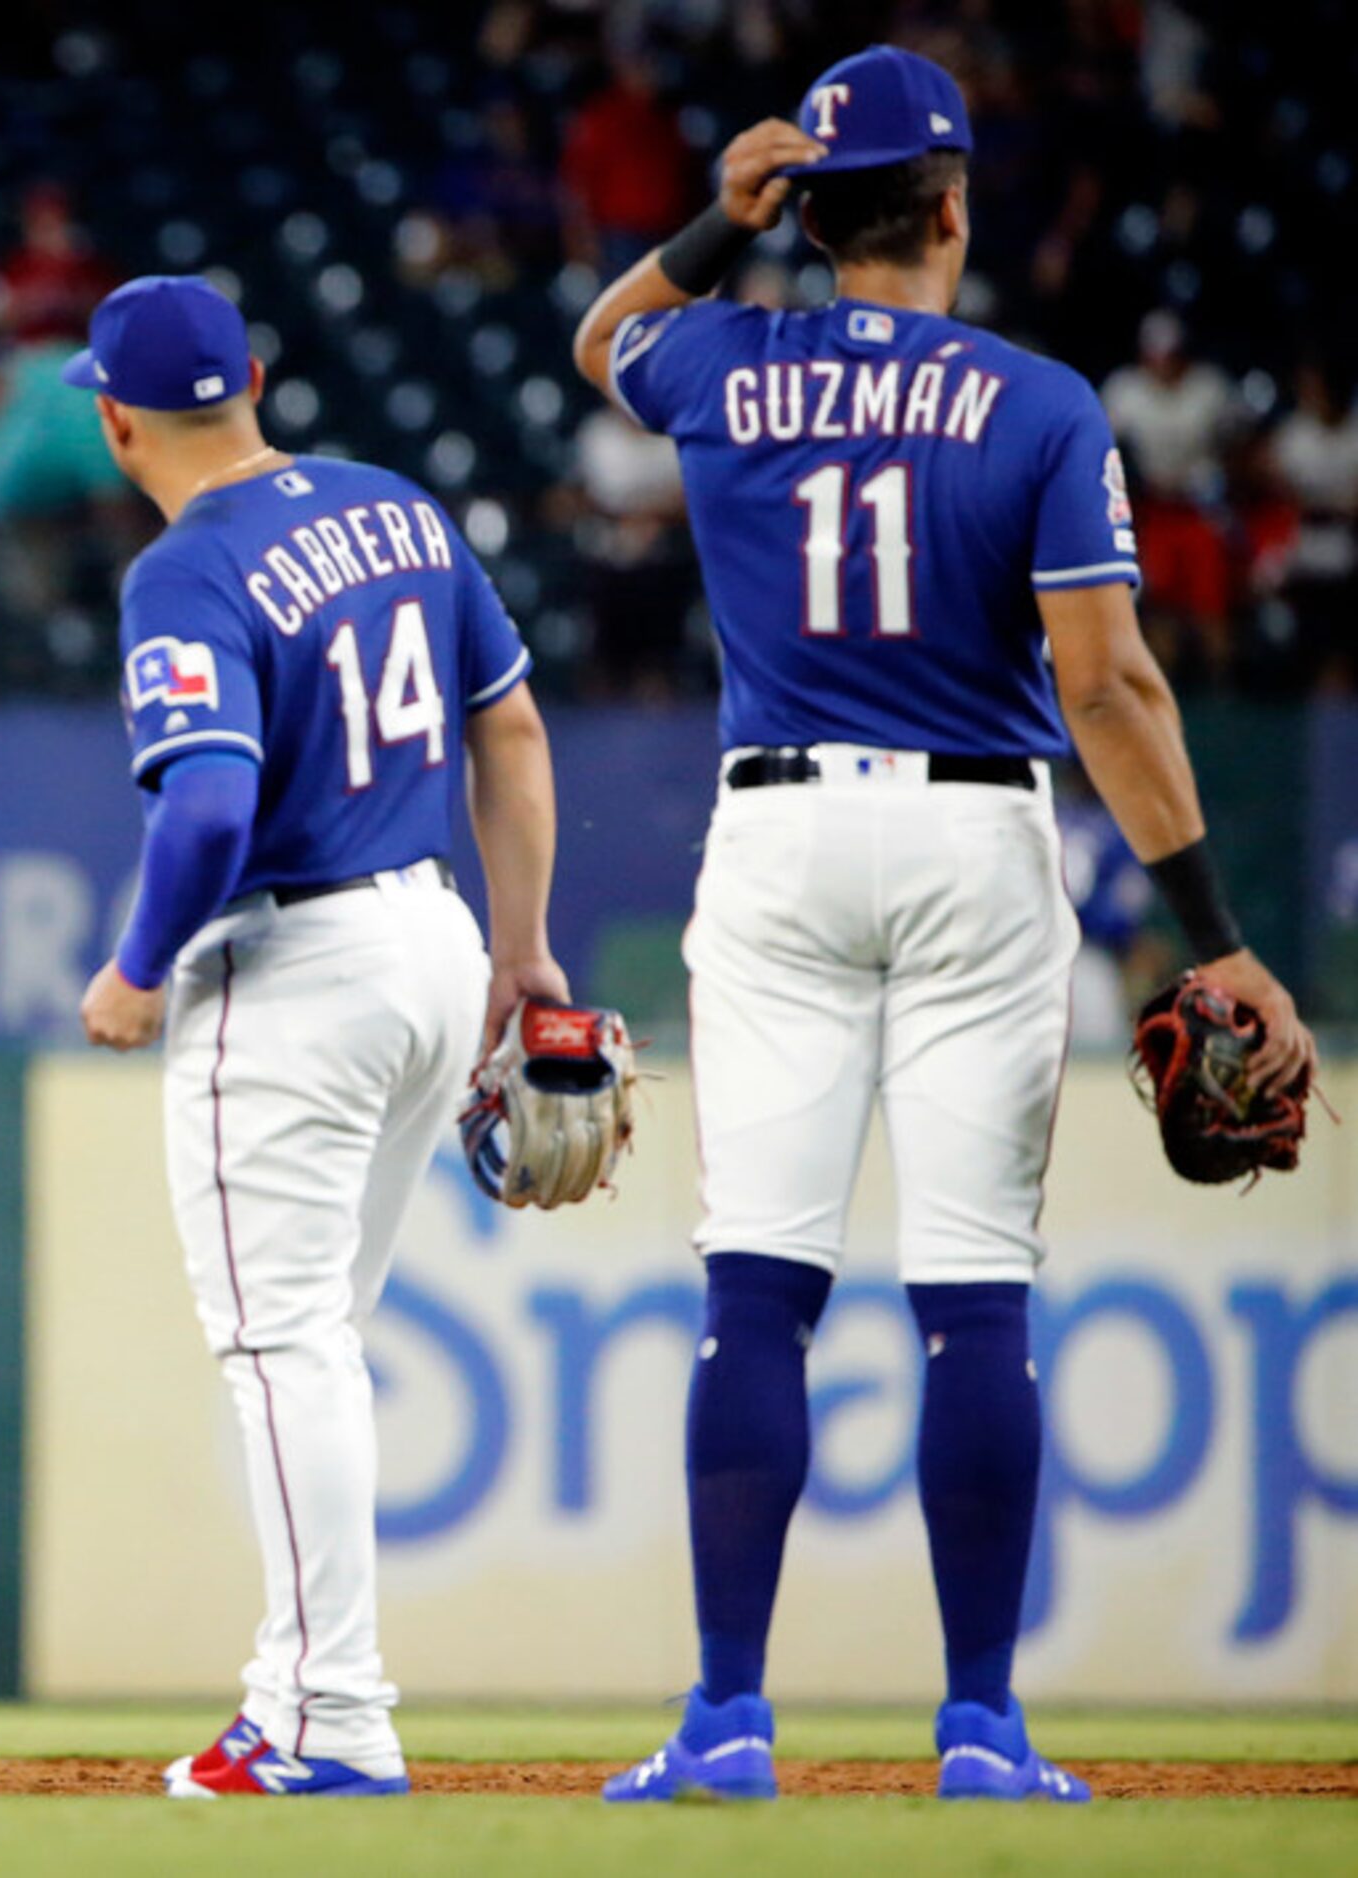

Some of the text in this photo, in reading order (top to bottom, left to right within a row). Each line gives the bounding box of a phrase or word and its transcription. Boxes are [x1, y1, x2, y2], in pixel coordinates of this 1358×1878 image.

[811, 83, 850, 139] T
[723, 342, 1006, 446] GUZMÁN
[246, 499, 453, 638] CABRERA
[793, 462, 918, 638] 11
[326, 599, 446, 794] 14
